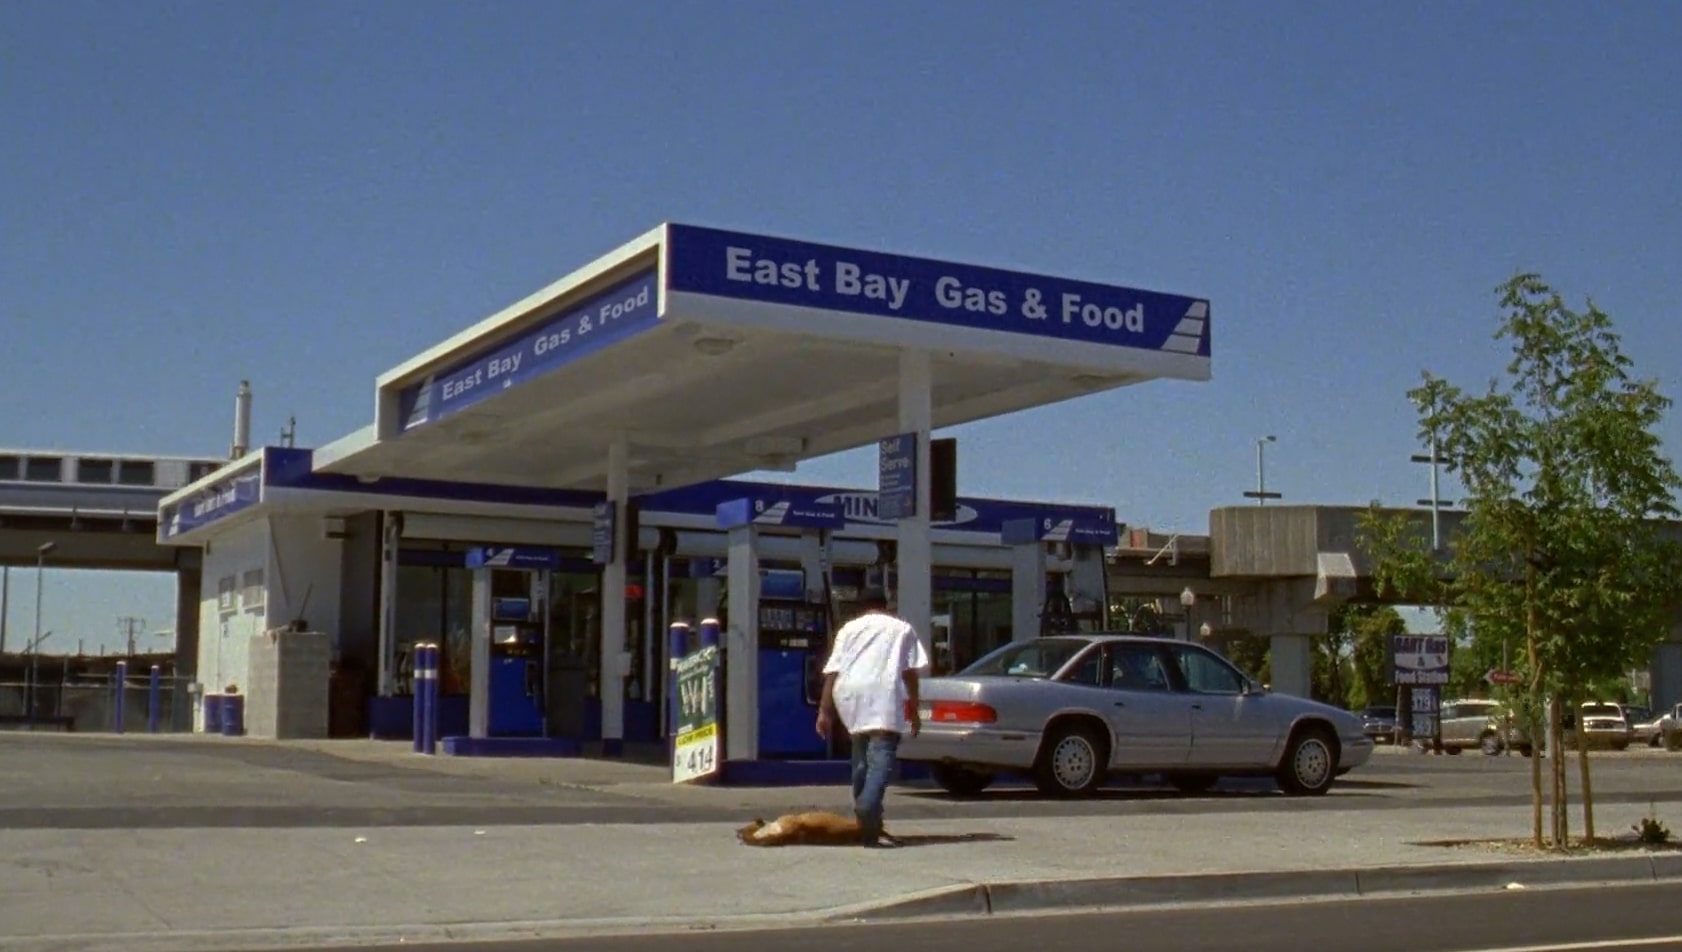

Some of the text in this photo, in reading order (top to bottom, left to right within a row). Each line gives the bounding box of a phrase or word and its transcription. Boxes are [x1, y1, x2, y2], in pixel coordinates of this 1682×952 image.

[725, 246, 1144, 333] East Bay Gas & Food
[442, 285, 649, 401] East Bay Gas & Food
[881, 457, 910, 472] Serve
